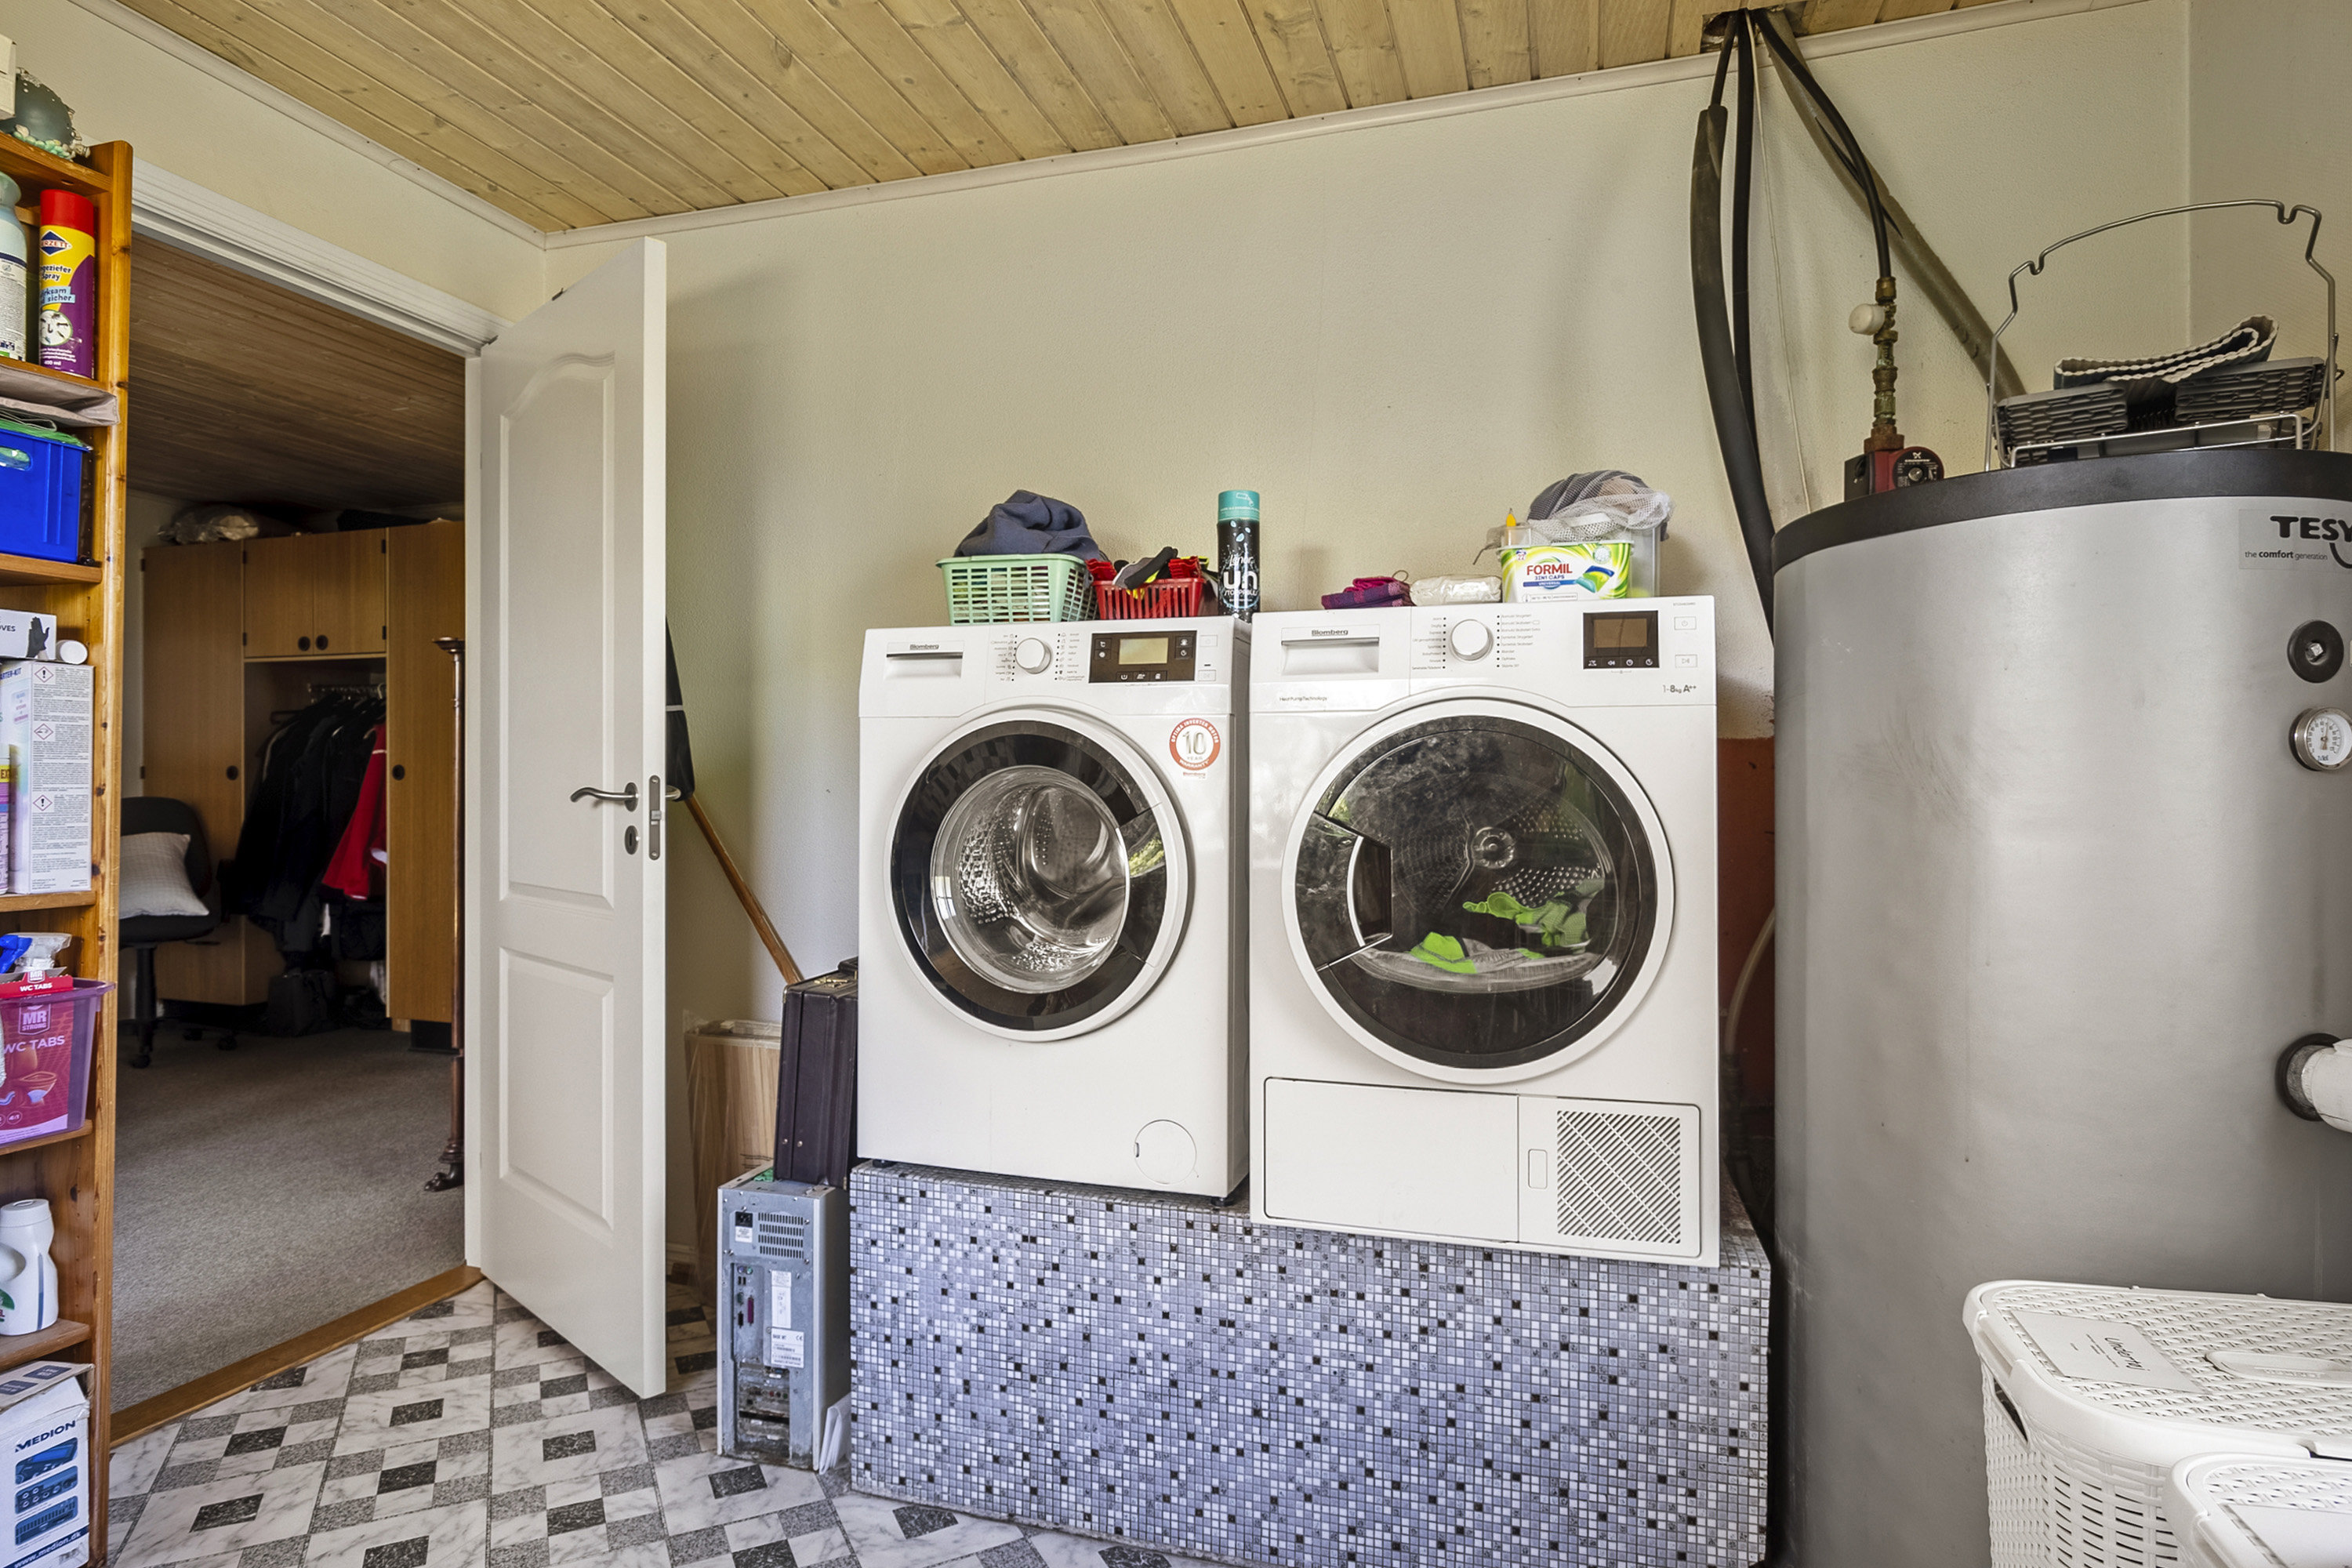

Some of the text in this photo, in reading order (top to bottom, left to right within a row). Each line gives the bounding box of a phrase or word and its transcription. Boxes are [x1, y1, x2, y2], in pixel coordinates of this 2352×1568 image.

[2270, 516, 2352, 542] TESY
[1526, 564, 1573, 575] FORMIL
[1182, 731, 1207, 755] 10
[22, 1022, 47, 1032] STRONG
[23, 1010, 47, 1025] MR
[3, 1035, 66, 1054] WC TABS
[15, 1420, 76, 1453] MEDION
[14, 1531, 82, 1568] www.medion.dk
